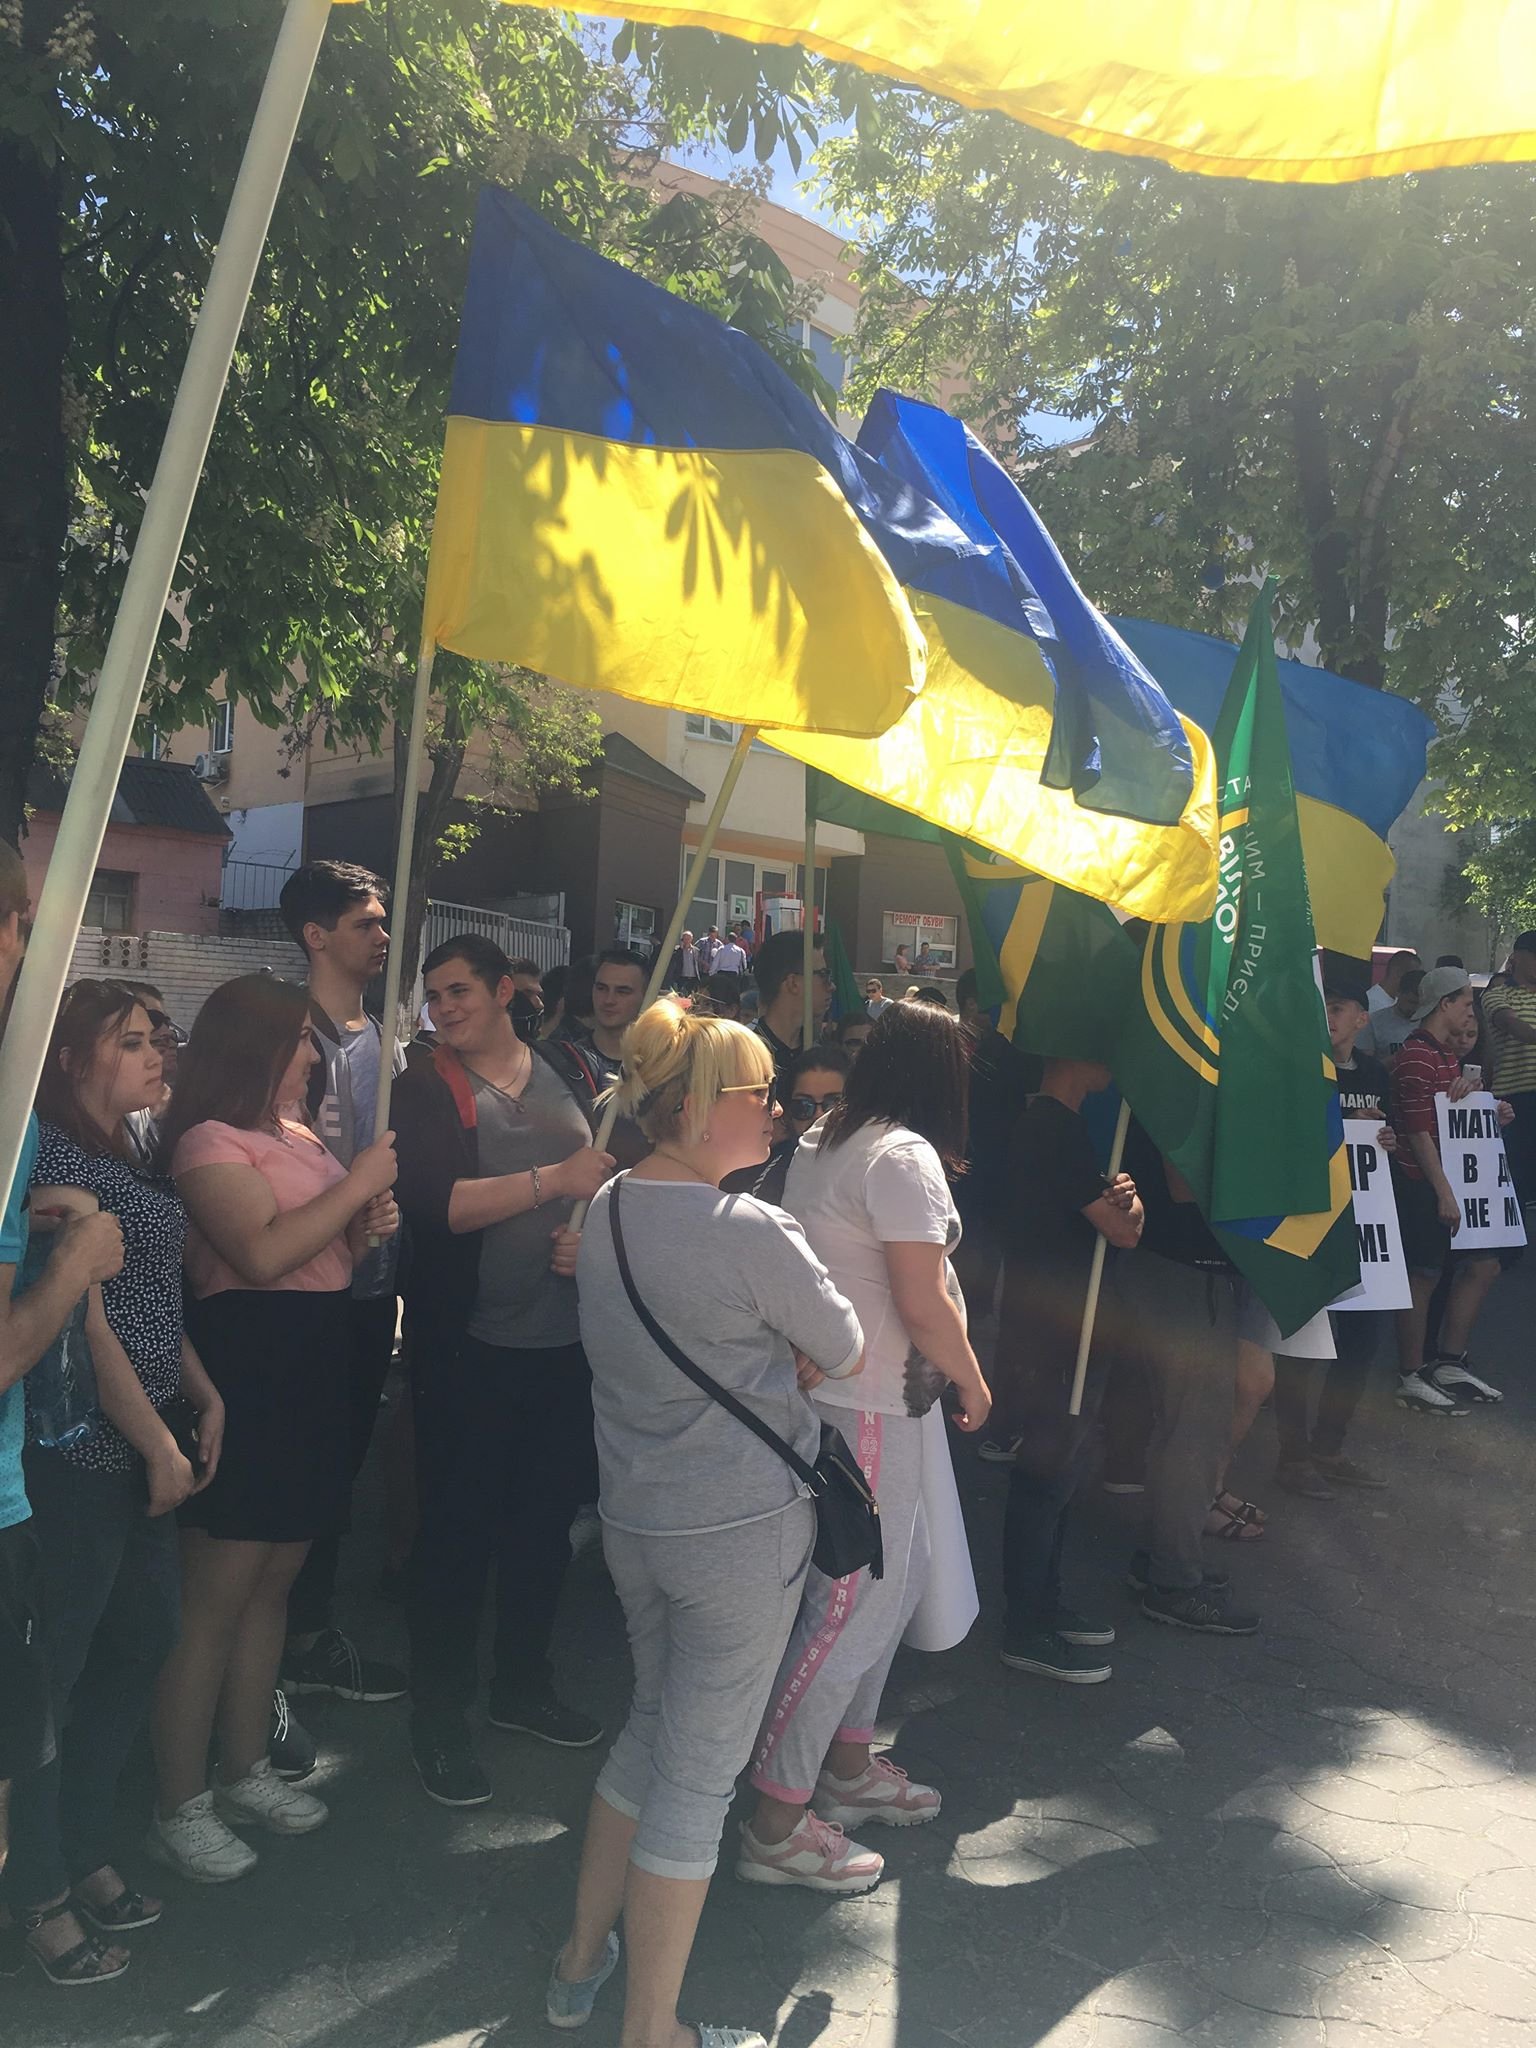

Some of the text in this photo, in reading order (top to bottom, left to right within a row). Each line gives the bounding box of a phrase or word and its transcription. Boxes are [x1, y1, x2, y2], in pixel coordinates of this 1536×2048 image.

[895, 914, 944, 927] РЕМОНТ ОБУВИ
[1222, 924, 1267, 1021] ПРИЄД
[1463, 1153, 1478, 1183] В
[1464, 1198, 1490, 1228] НЕ
